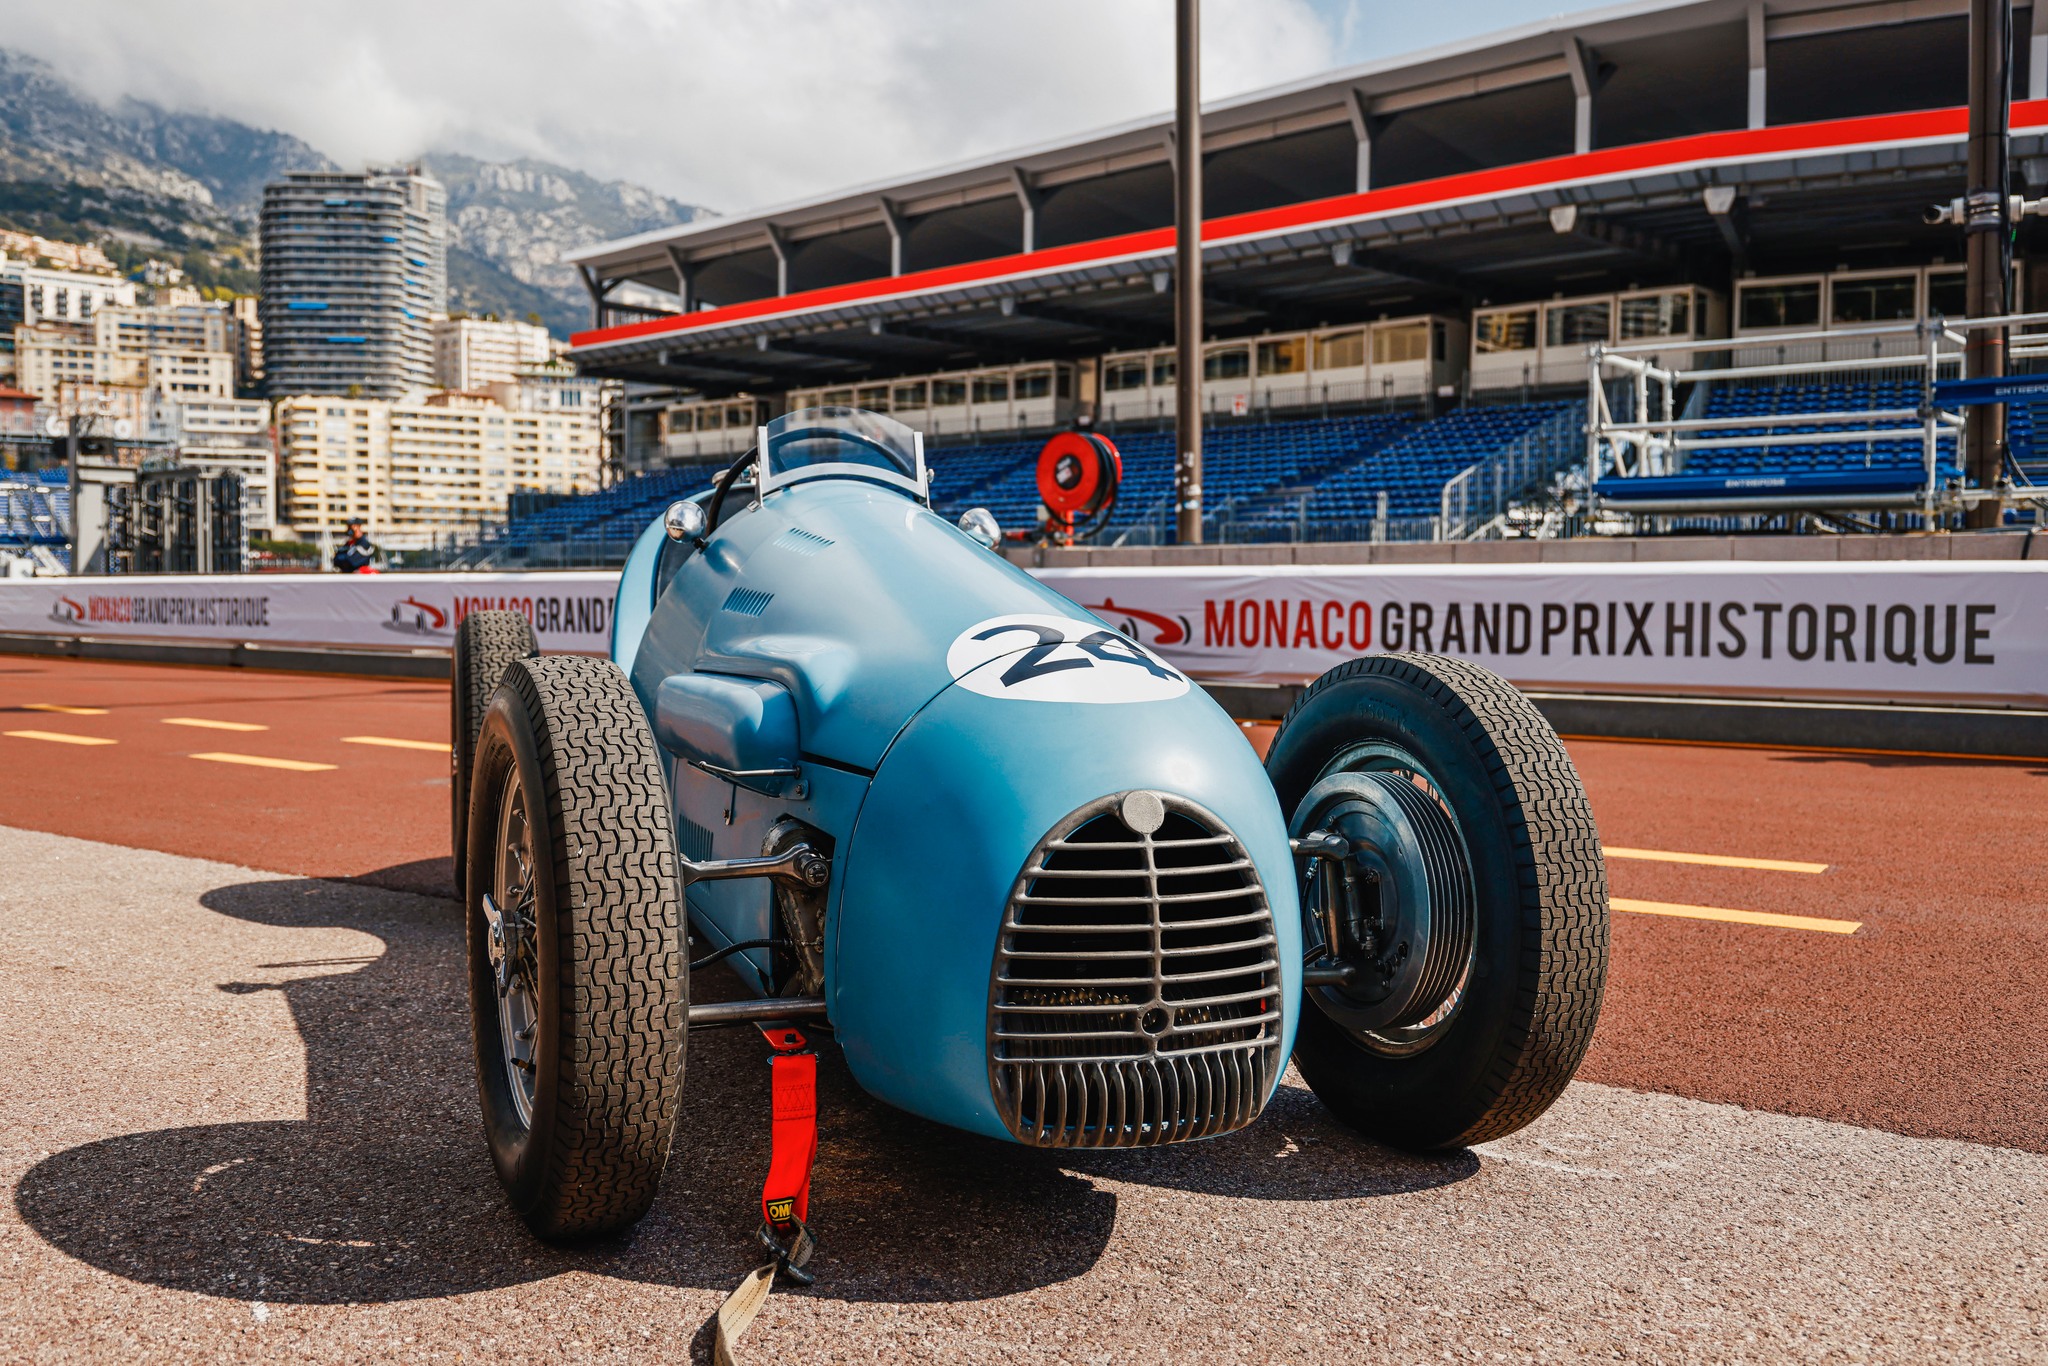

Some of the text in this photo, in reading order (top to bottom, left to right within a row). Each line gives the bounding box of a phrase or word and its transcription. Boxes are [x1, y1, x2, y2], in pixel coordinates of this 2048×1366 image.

[88, 596, 131, 624] MONACO
[131, 596, 168, 625] GRAND
[197, 597, 270, 627] HISTORIQUE
[535, 596, 606, 634] GRAND
[1204, 599, 1997, 667] MONACO GRAND PRIX HISTORIQUE
[970, 624, 1184, 688] 24
